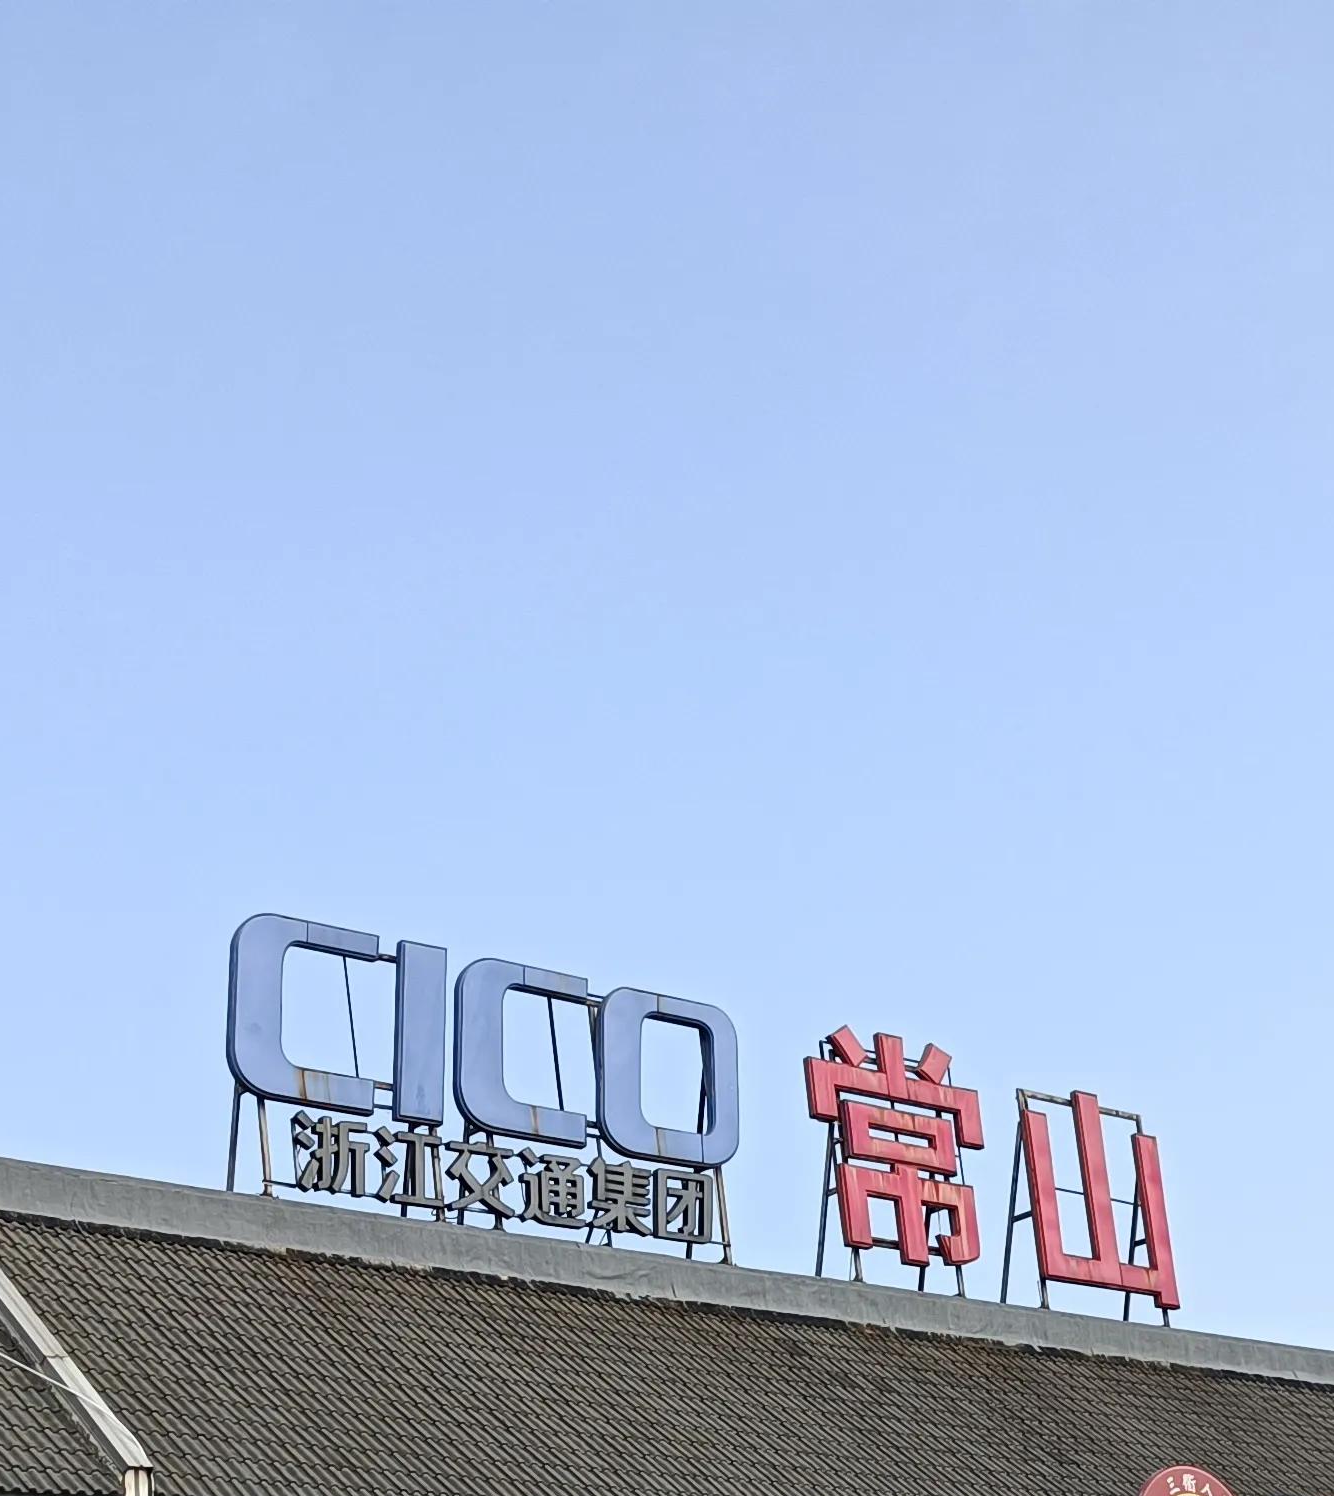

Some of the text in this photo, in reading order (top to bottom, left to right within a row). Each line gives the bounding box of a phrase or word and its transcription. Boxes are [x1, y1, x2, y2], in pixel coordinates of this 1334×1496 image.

[227, 913, 739, 1167] CICO
[803, 1024, 1181, 1310] 常山
[290, 1109, 714, 1245] 浙江交通集团
